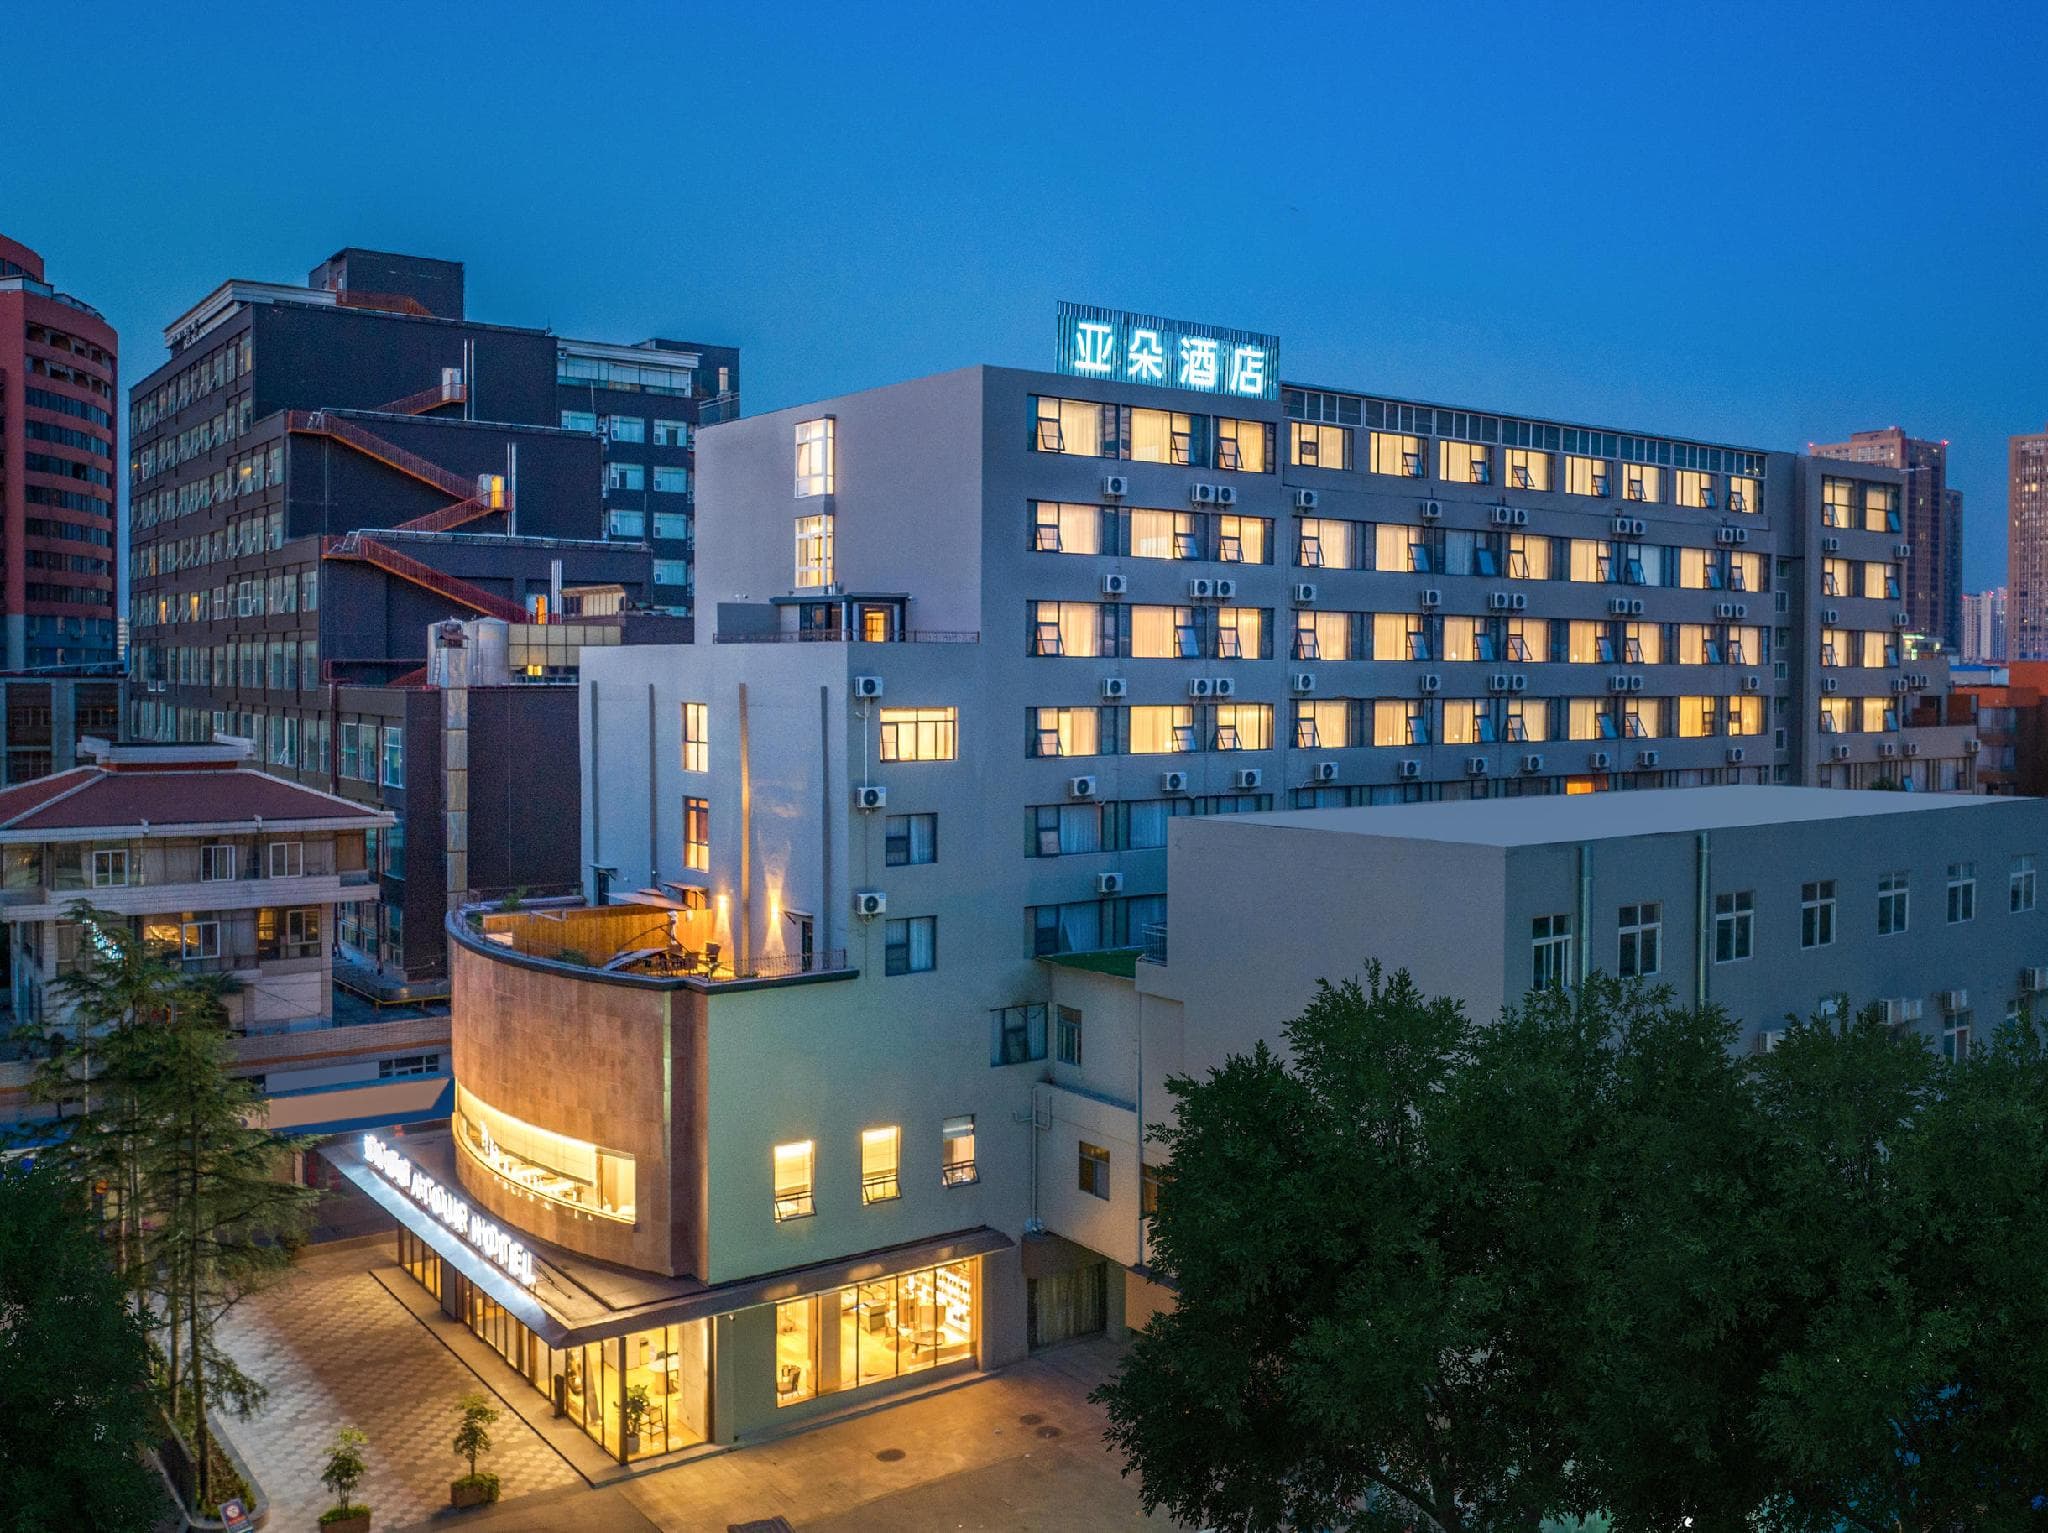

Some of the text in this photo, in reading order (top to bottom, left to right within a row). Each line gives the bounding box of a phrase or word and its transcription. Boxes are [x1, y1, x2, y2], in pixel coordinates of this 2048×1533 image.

[1073, 321, 1266, 394] 亚朵酒店
[410, 1172, 537, 1286] ATOUR HOTEL
